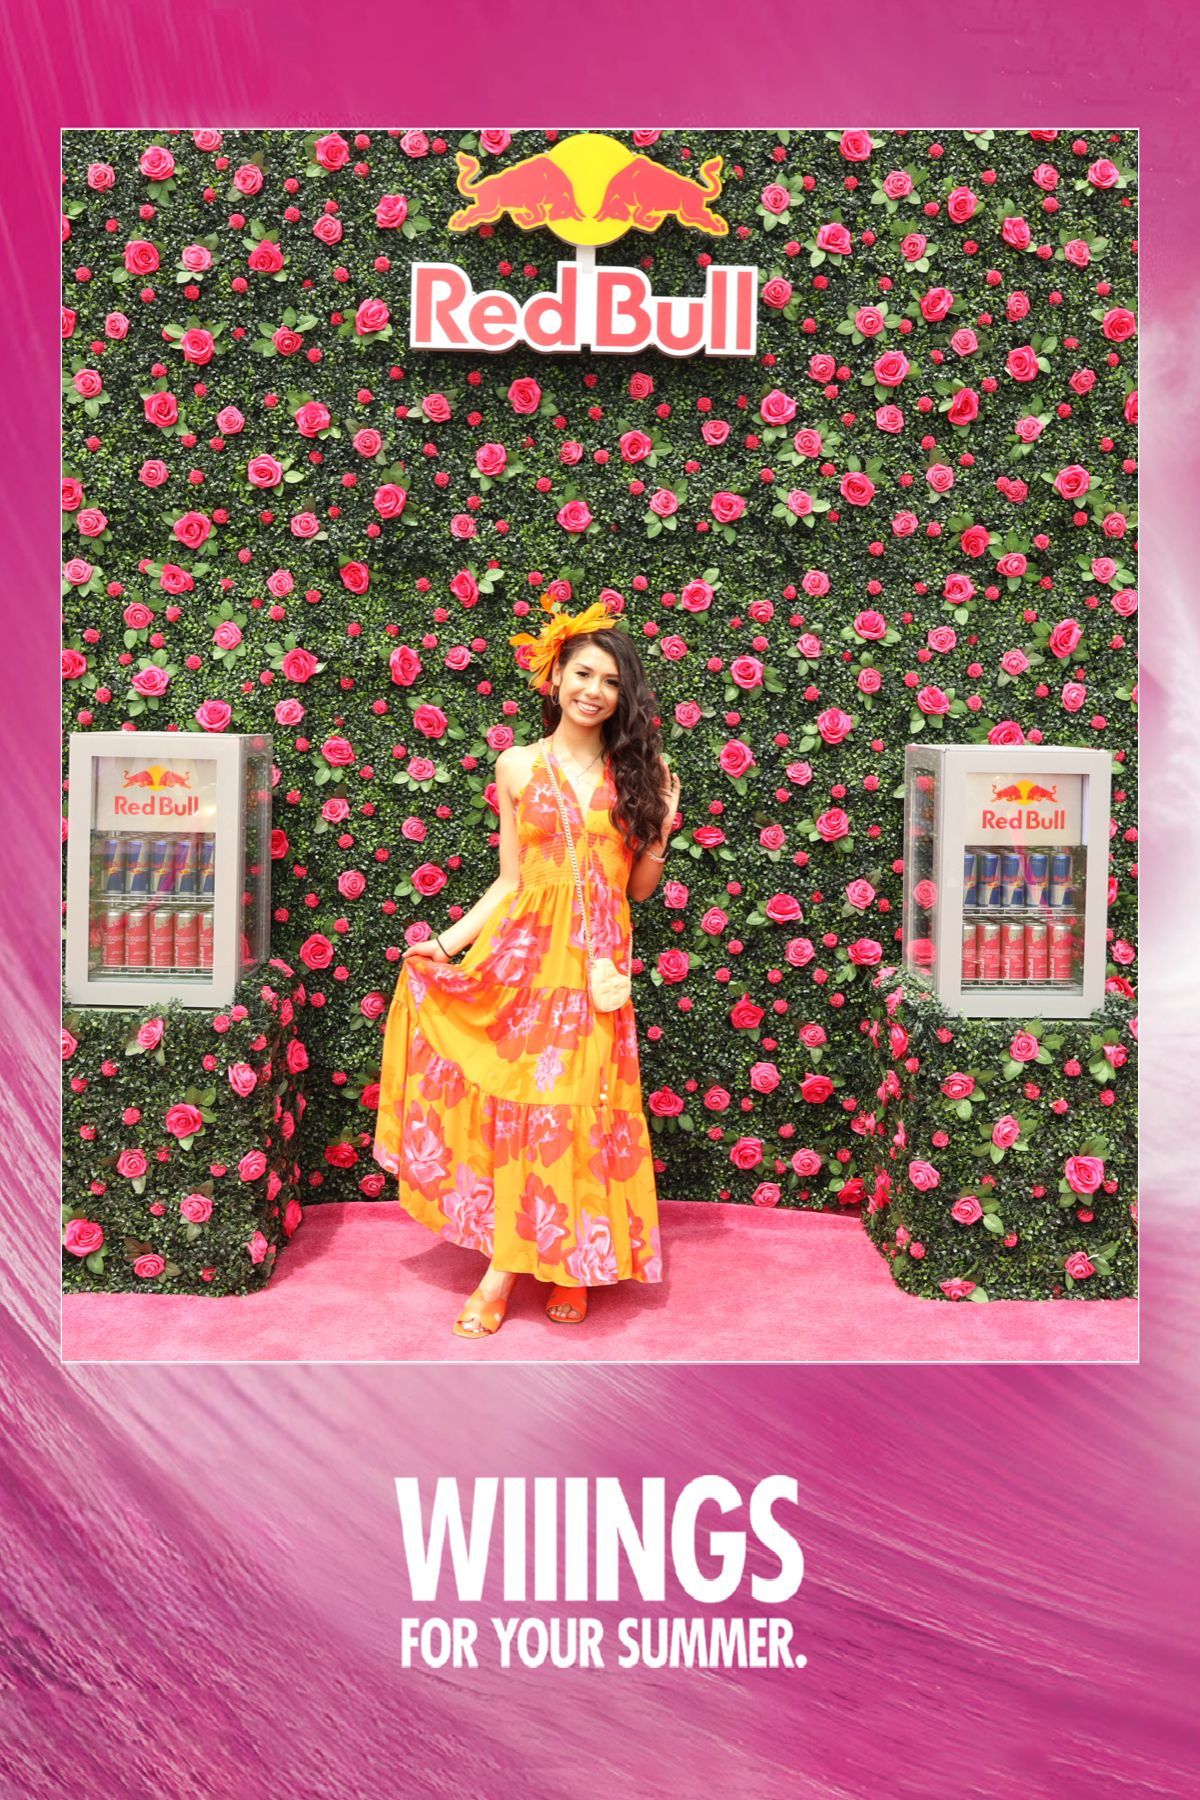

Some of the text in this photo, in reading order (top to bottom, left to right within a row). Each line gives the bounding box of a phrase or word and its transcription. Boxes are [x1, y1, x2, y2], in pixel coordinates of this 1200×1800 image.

[415, 267, 753, 351] Red Bull
[114, 796, 199, 816] Red Bull
[982, 810, 1065, 830] Red Bull
